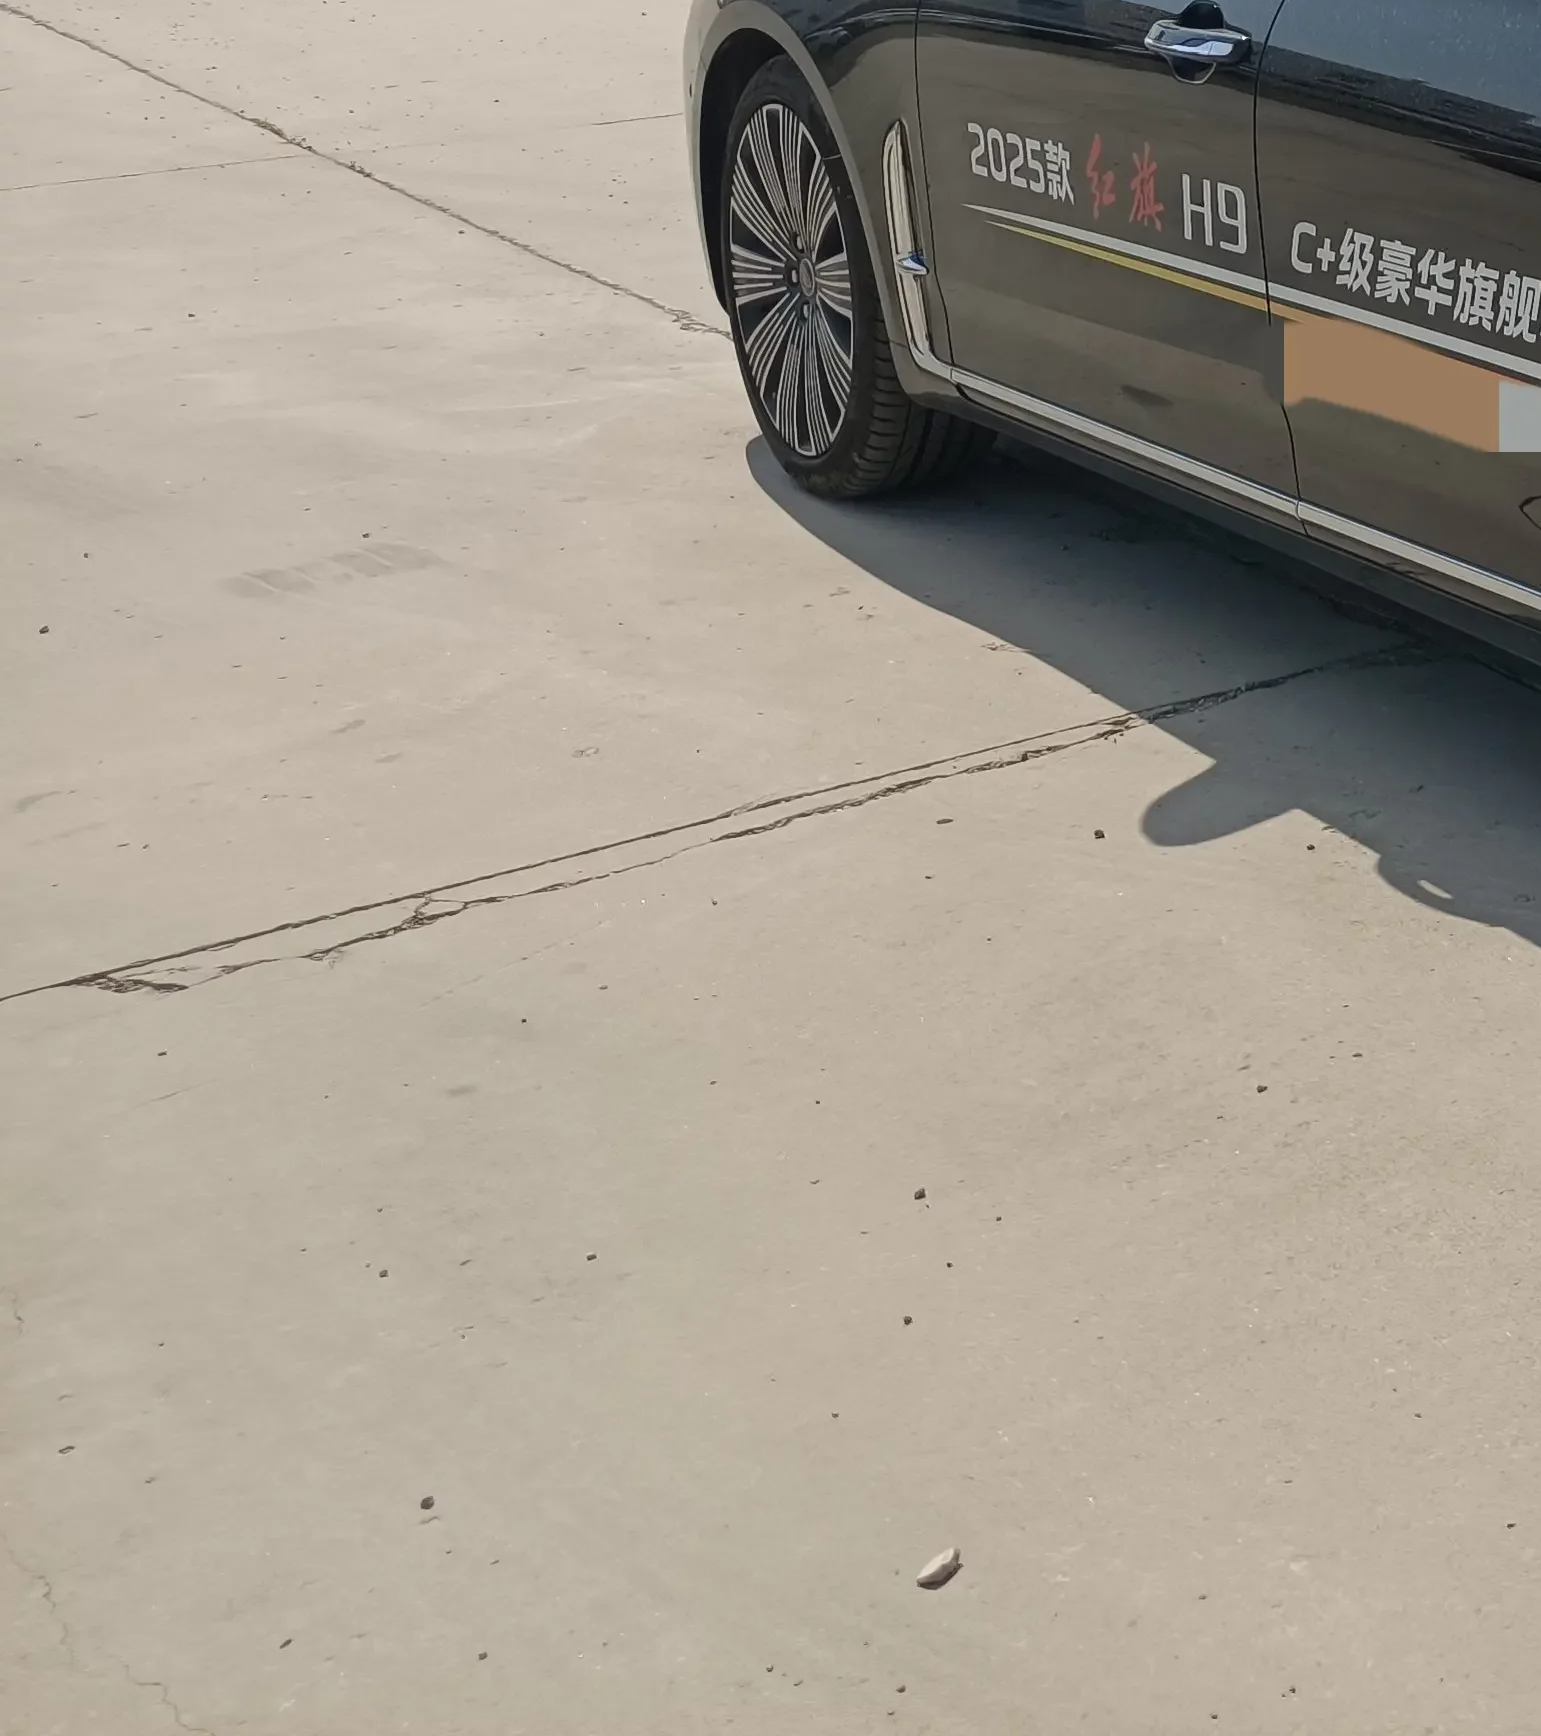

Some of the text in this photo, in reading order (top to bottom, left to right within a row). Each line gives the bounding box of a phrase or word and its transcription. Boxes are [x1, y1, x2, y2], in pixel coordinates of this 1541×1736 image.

[967, 122, 1248, 254] 2025款 红旗 H9
